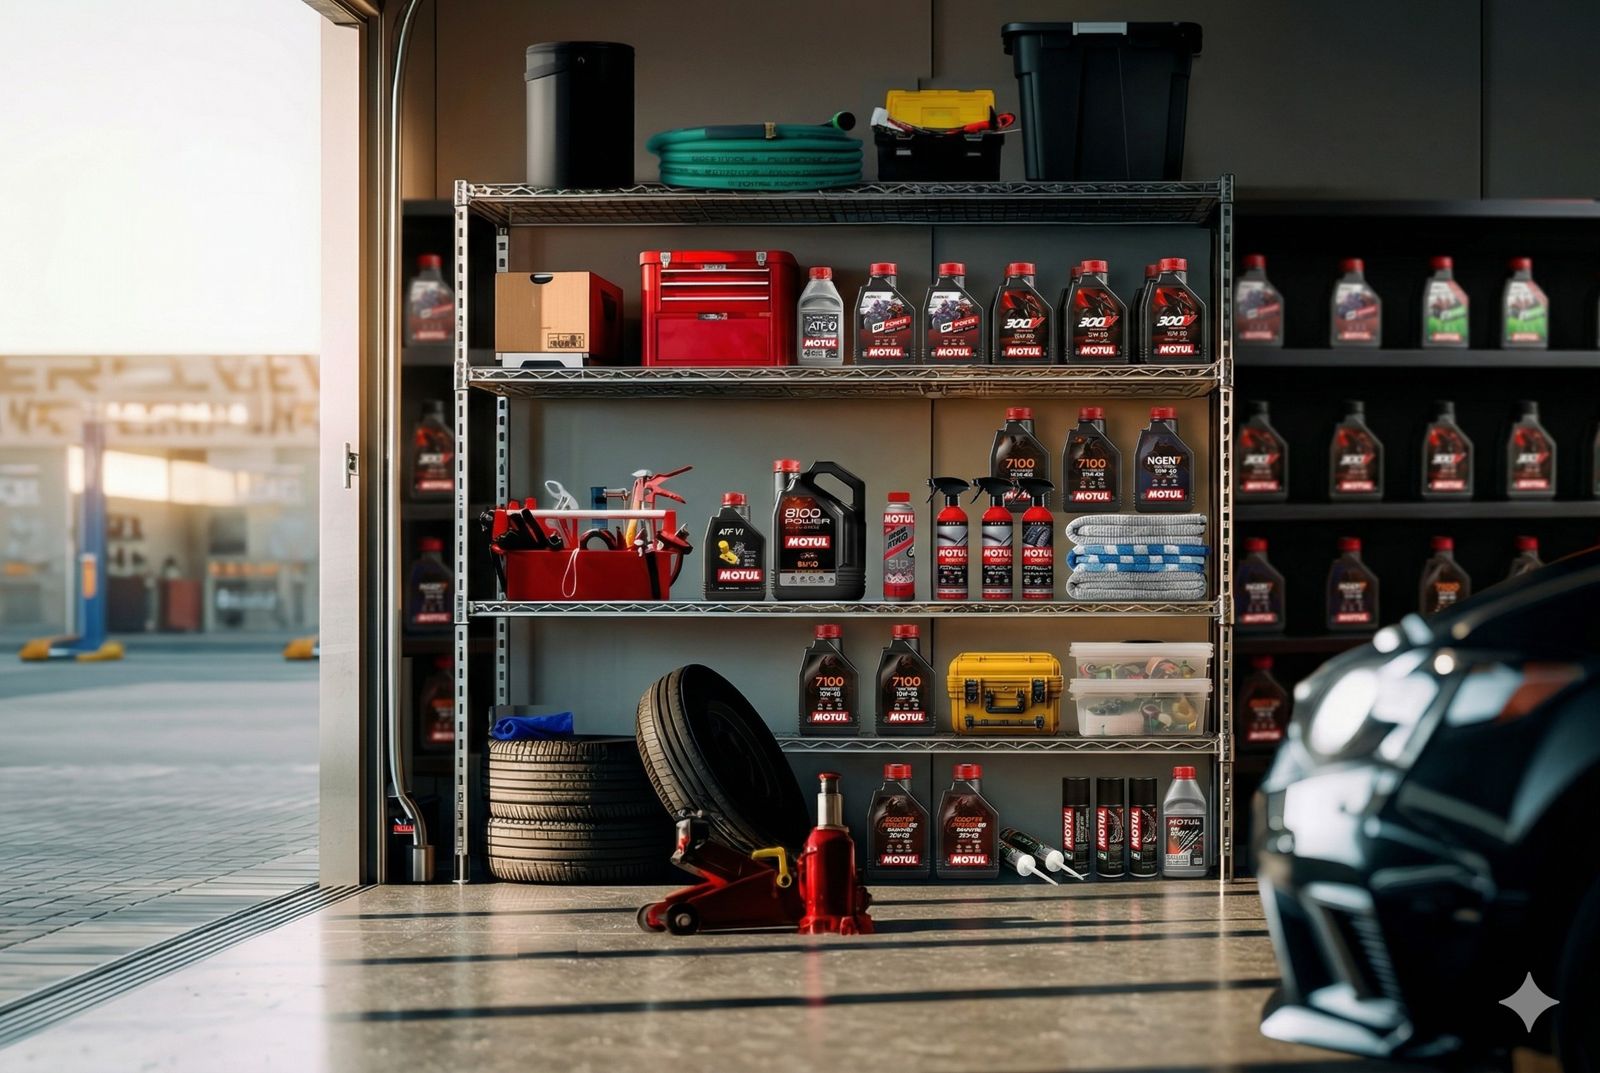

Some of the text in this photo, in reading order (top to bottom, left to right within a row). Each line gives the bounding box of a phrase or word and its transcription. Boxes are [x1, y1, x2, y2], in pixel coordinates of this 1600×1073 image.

[1004, 316, 1046, 329] 300V
[1078, 316, 1119, 327] 300V
[1156, 314, 1198, 327] 300V
[805, 339, 836, 347] MOTUL
[869, 348, 901, 356] MOTUL
[937, 347, 970, 356] MOTUL
[1007, 347, 1040, 356] MOTUL
[1081, 346, 1114, 355] MOTUL
[1160, 345, 1193, 353] MOTUL
[1005, 458, 1035, 468] 7100
[1078, 458, 1106, 468] 7100
[1147, 456, 1182, 465] NGEN7
[1075, 492, 1109, 500] MOTUL
[1148, 490, 1182, 498] MOTUL
[785, 508, 821, 518] 8100
[718, 528, 744, 536] ATF VI
[787, 537, 828, 546] MOTUL
[720, 571, 760, 580] MOTUL
[815, 676, 844, 686] 7100
[892, 676, 921, 686] 7100
[813, 713, 847, 721] MOTUL
[890, 713, 923, 721] MOTUL
[1131, 810, 1139, 848] MOTUL
[883, 855, 917, 864] MOTUL
[952, 855, 986, 864] MOTUL
